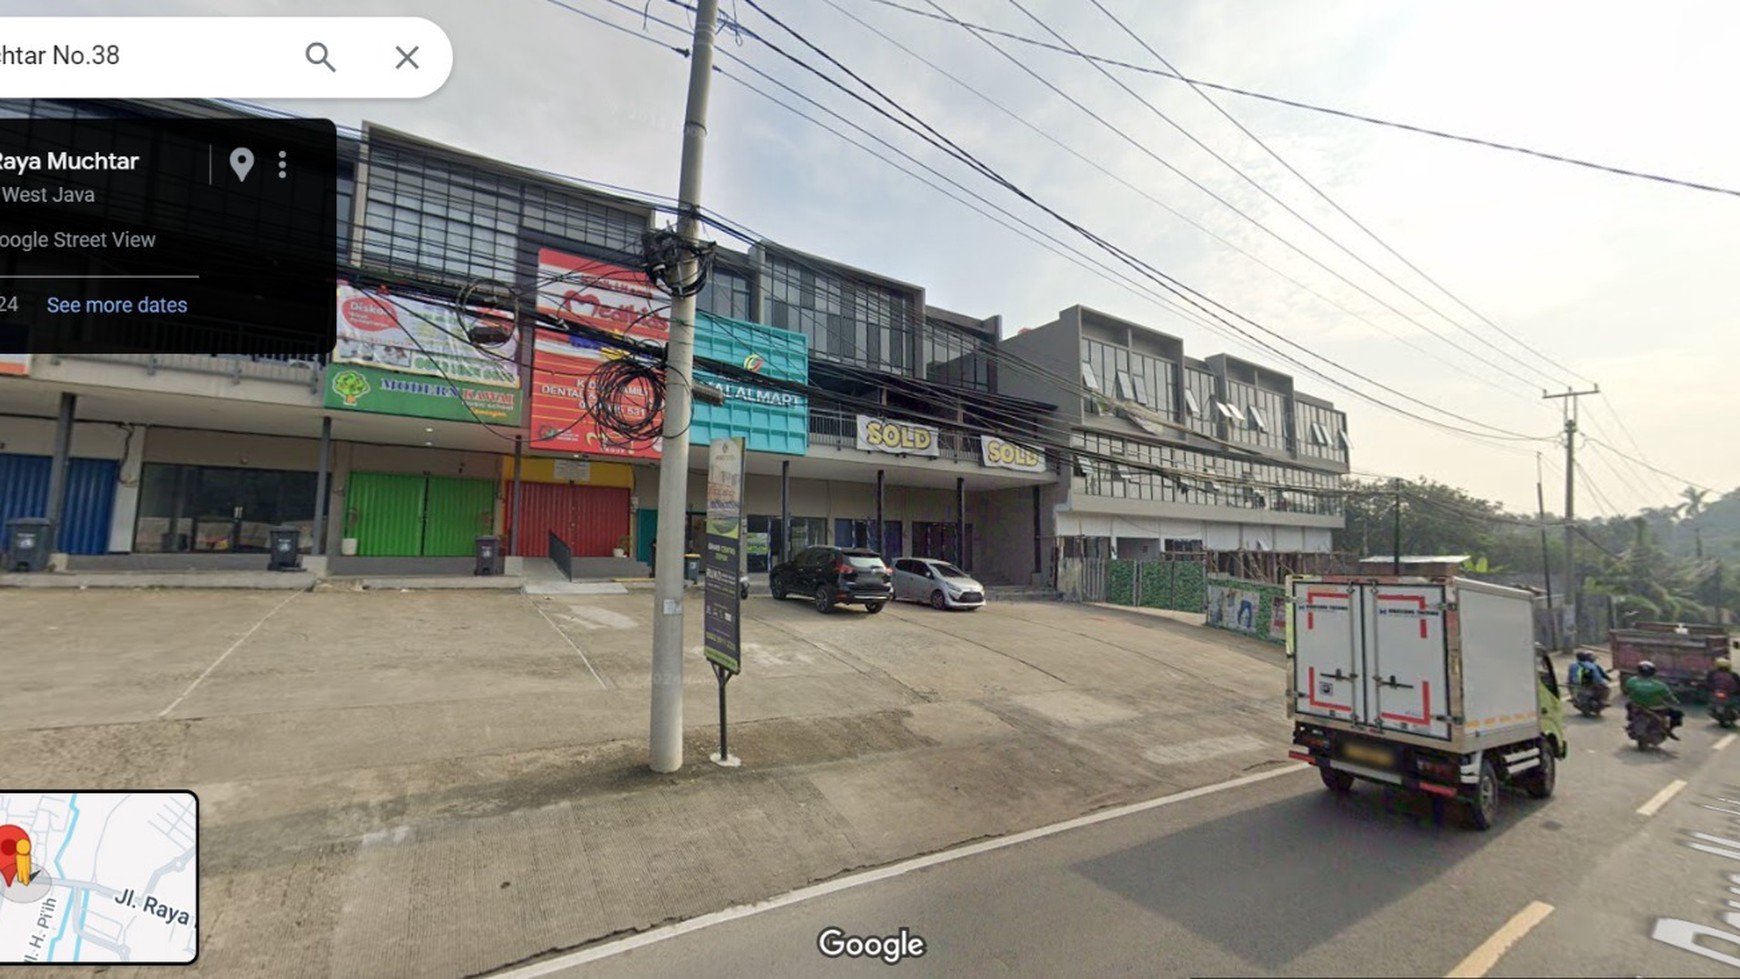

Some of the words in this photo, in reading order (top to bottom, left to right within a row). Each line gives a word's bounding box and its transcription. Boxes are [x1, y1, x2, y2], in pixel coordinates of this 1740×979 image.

[380, 378, 460, 398] MODERN
[542, 385, 585, 400] DENTAL
[701, 379, 800, 407] ALALMART
[866, 421, 931, 450] SOLD
[987, 440, 1040, 467] SOLD
